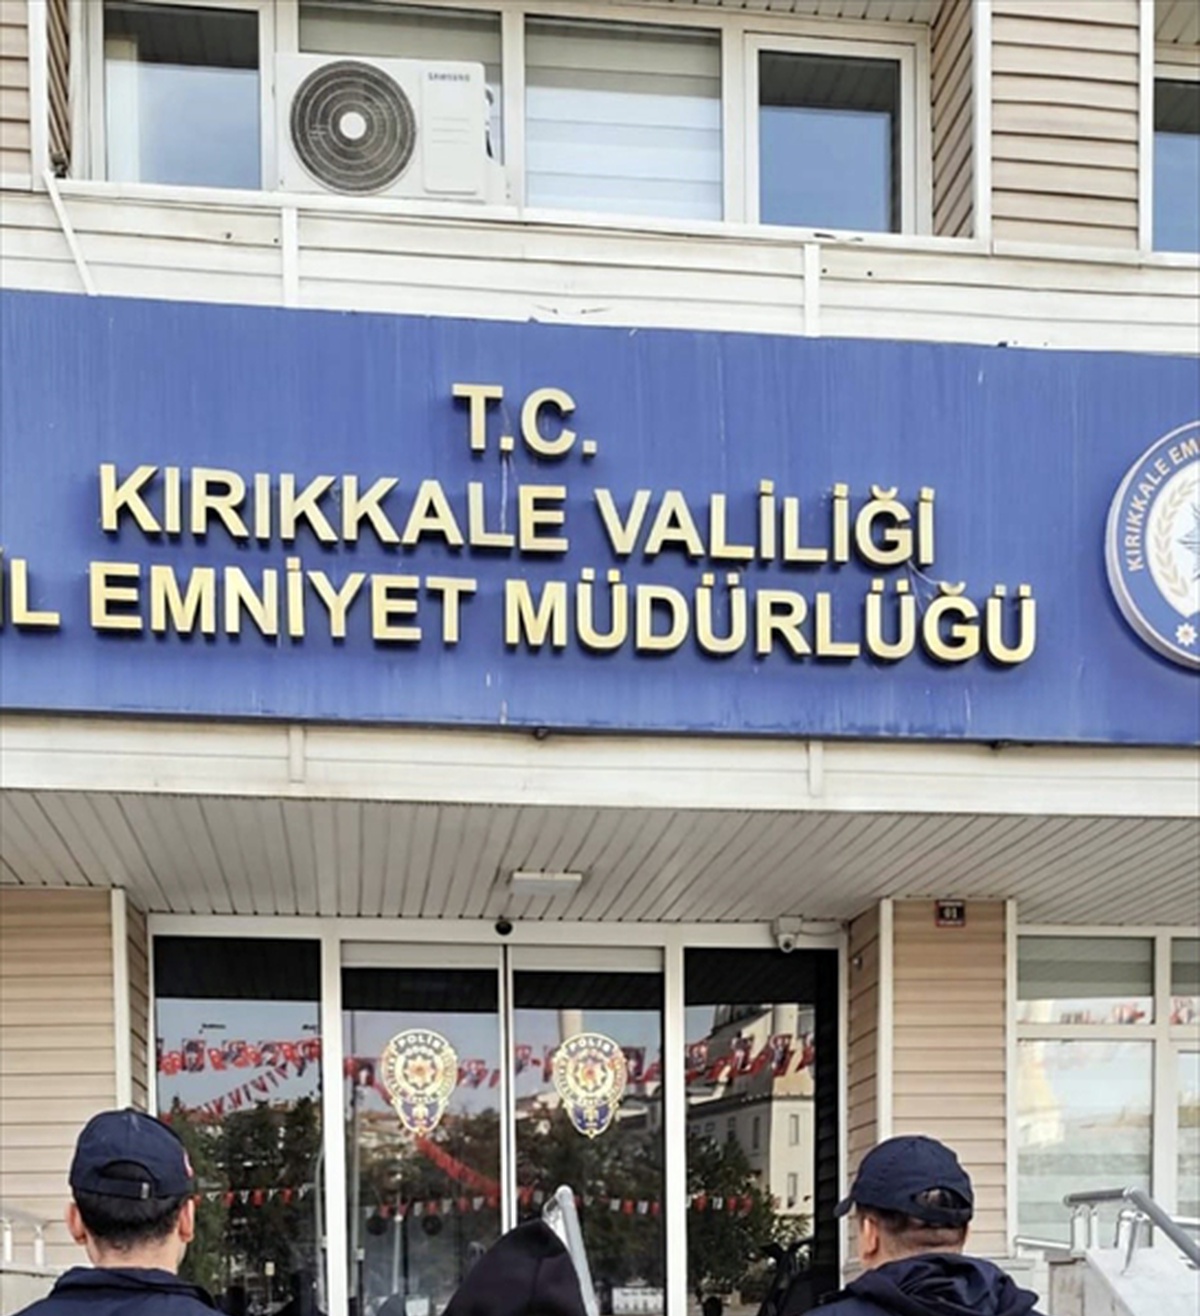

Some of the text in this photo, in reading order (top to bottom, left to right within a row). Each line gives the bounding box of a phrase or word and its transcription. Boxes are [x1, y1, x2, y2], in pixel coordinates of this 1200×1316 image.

[452, 383, 597, 456] T.C.
[98, 463, 936, 567] KIRIKKALE VALİLİĞİ
[1125, 458, 1171, 572] KIRIKKALE
[0, 546, 1037, 664] L EMNİYET MÜDÜRLÜĞÜ
